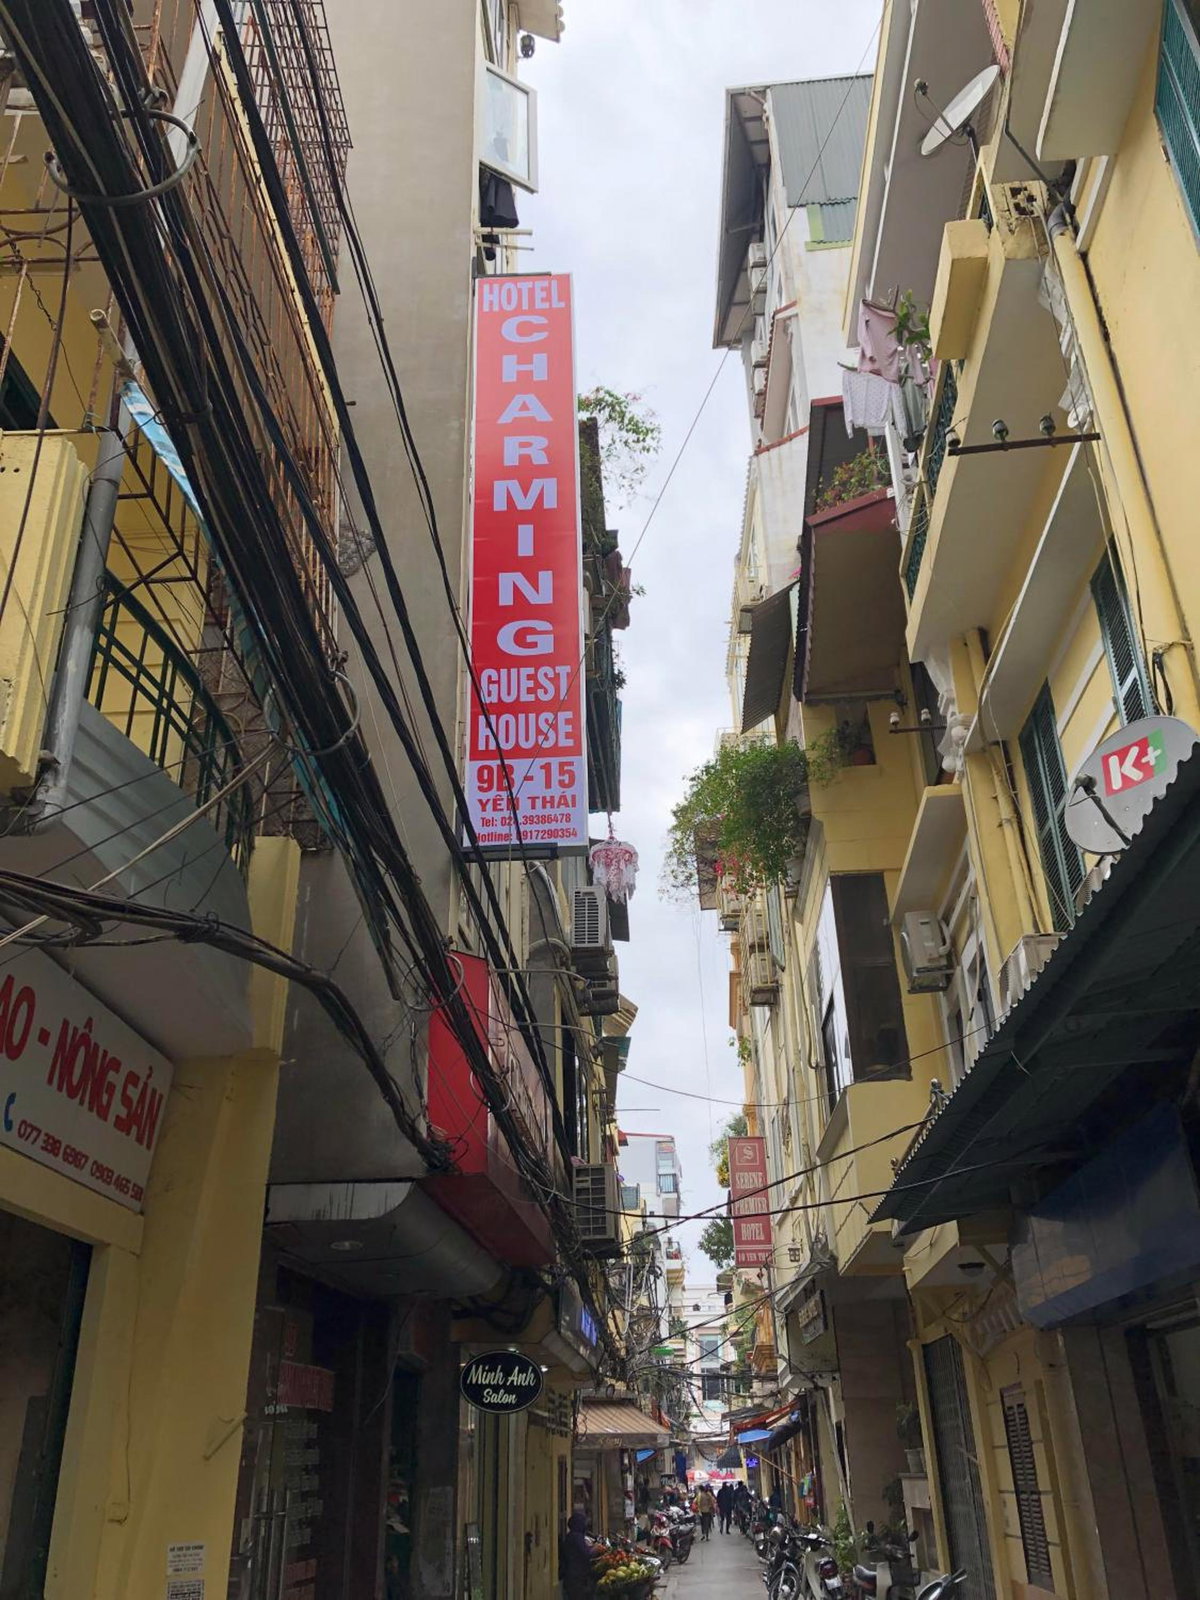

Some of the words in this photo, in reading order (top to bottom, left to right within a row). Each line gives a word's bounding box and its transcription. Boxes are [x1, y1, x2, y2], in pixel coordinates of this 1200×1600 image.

[482, 279, 565, 312] HOTEL
[493, 315, 558, 656] CHARMING
[481, 666, 571, 703] GUEST
[478, 711, 574, 751] HOUSE
[540, 761, 576, 790] 15
[1109, 746, 1161, 790] K+
[477, 794, 520, 812] YÊN
[527, 791, 577, 810] THÁI
[480, 816, 498, 828] Tel:
[46, 1016, 122, 1123] NÔNG
[113, 1065, 164, 1152] SẢN
[736, 1172, 763, 1189] SERENE
[741, 1223, 765, 1240] HOTEL
[467, 1364, 505, 1386] Minh
[506, 1365, 536, 1387] Anh
[482, 1388, 518, 1405] Salon
